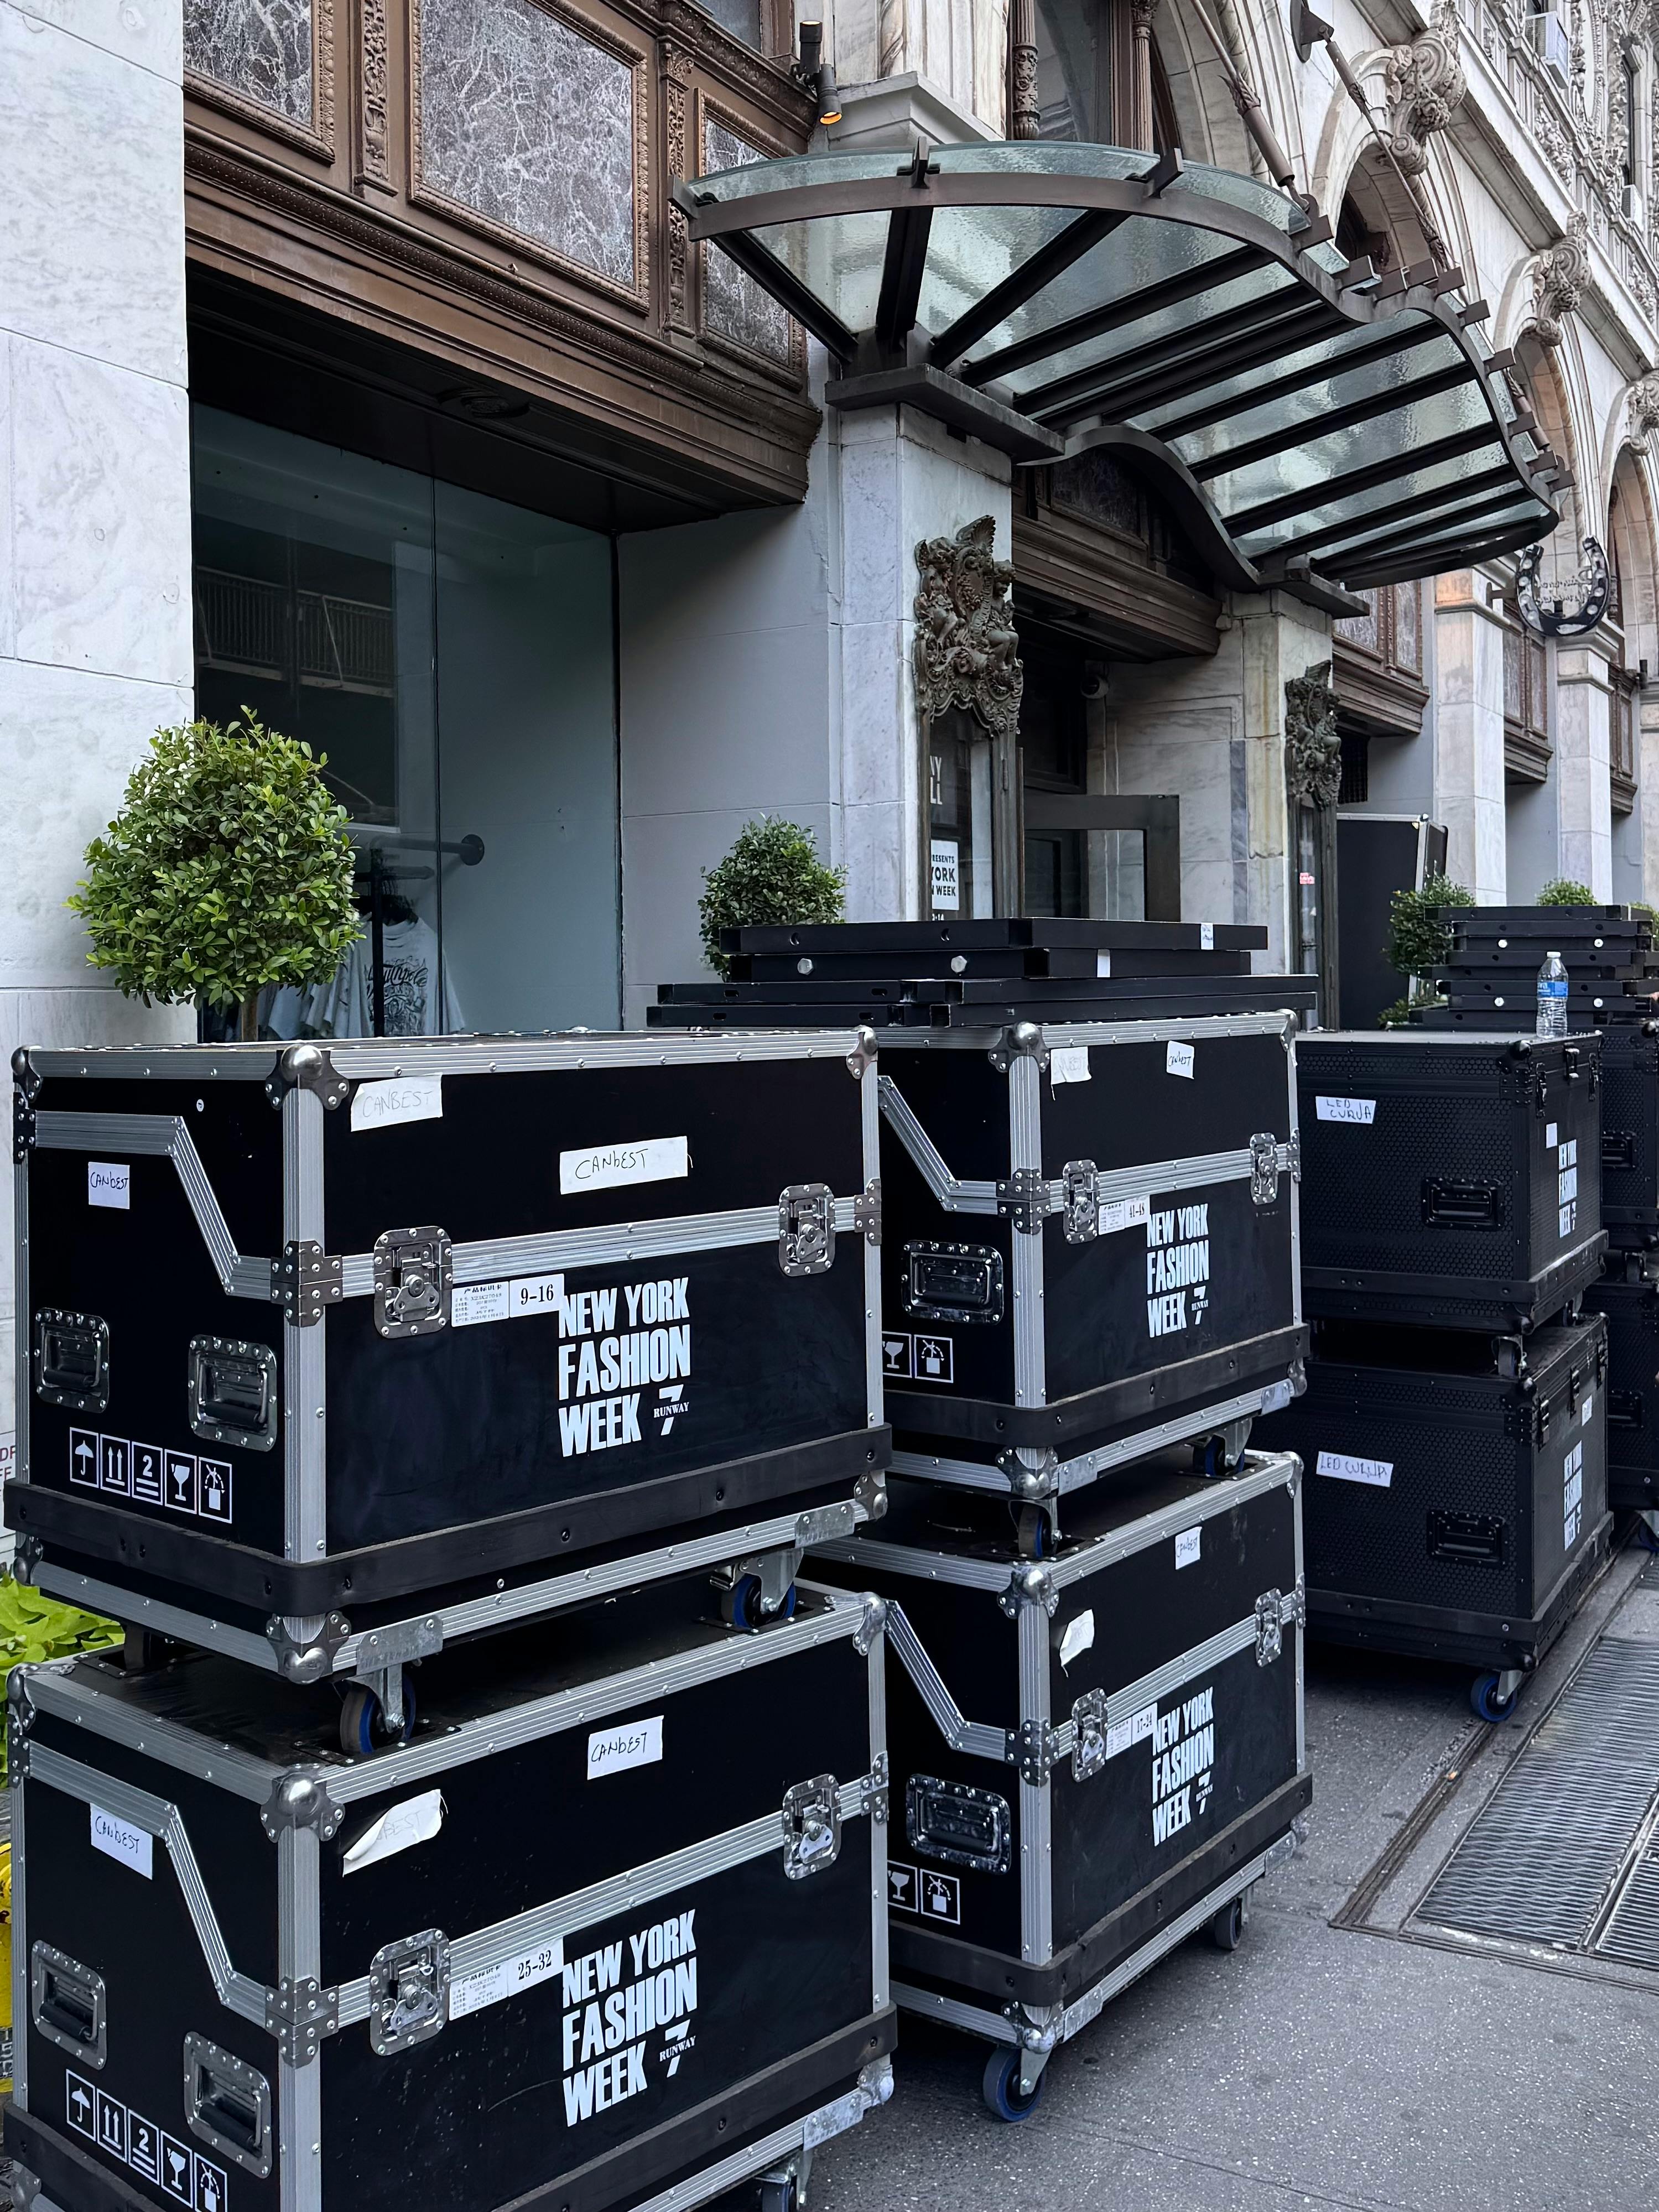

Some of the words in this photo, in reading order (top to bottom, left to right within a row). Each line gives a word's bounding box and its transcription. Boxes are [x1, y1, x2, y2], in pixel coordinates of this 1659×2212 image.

[930, 777, 942, 805] LL
[932, 855, 954, 863] RESENTS
[936, 885, 955, 897] WEEK
[363, 1089, 433, 1117] CANBEST
[1327, 1099, 1350, 1108] LED
[1147, 1210, 1174, 1247] NEW
[1177, 1203, 1209, 1240] YORK
[1147, 1240, 1209, 1294] FASHION
[521, 1284, 553, 1305] 9-16
[559, 1288, 617, 1338] NEW
[624, 1277, 689, 1326] YORK
[1147, 1291, 1187, 1338] WEEK
[559, 1324, 690, 1400] FASHION
[558, 1393, 642, 1457] WEEK
[654, 1402, 689, 1418] RUNWAY
[1321, 1454, 1340, 1470] LED
[1152, 1707, 1180, 1756] NEW
[1183, 1687, 1213, 1735] YORK
[1152, 1723, 1214, 1804] FASHION
[377, 1810, 423, 1840] BEST
[1152, 1784, 1191, 1847] WEEK
[518, 1950, 552, 1980] 25-32
[563, 1941, 622, 2008] NEW
[630, 1909, 696, 1976] YORK
[563, 1957, 697, 2072] FASHION
[659, 2036, 696, 2062] RUNWAY
[563, 2041, 647, 2127] WEEK
